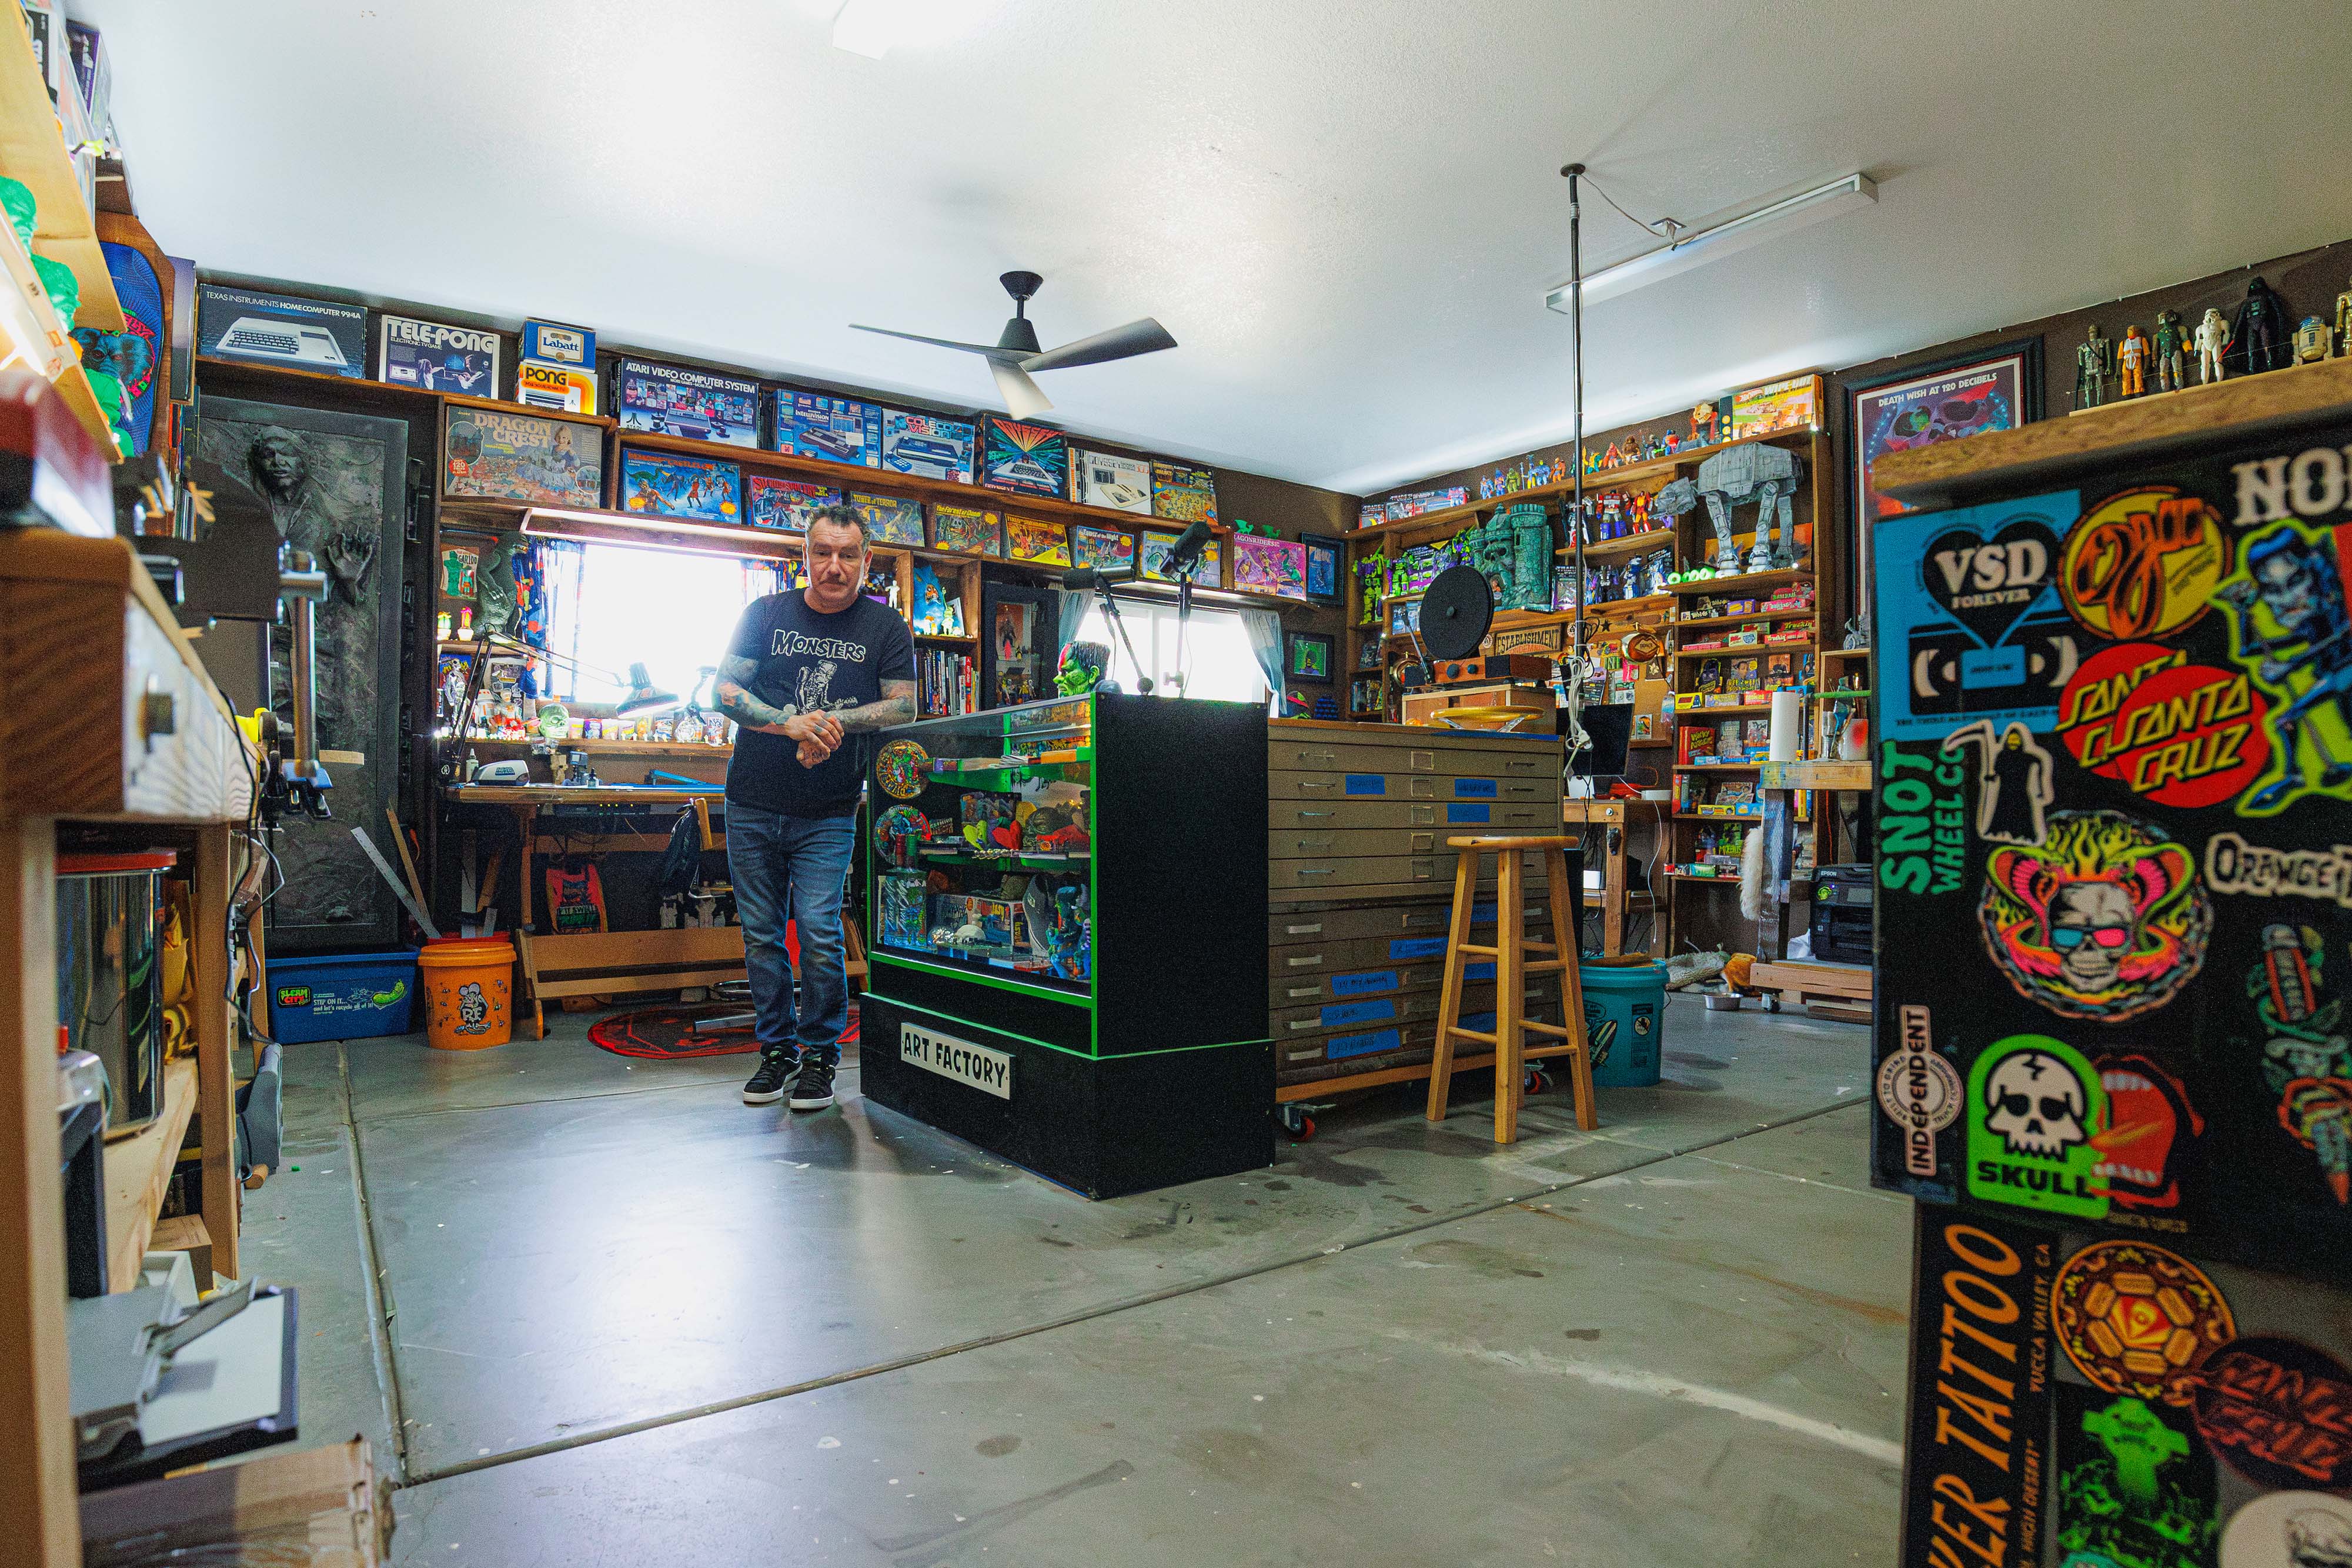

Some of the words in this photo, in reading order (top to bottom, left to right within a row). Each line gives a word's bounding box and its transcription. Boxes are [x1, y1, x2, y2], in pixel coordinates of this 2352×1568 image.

[206, 291, 228, 300] TEXAS
[229, 295, 280, 307] INSTRUMENTS
[280, 302, 303, 311] HOME
[303, 305, 340, 317] COMPUTER
[387, 319, 494, 354] TELE-PONG
[390, 337, 421, 346] ELECTRONIC
[543, 337, 579, 352] Labatt
[526, 367, 566, 386] PONG
[626, 362, 650, 375] ATARI
[651, 367, 678, 379] VIDEO
[680, 372, 724, 389] COMPUTER
[724, 380, 756, 393] SYSTEM
[1878, 393, 1905, 407] DEATH
[1906, 389, 1926, 400] WISH
[1929, 386, 1940, 396] AT
[1941, 382, 1956, 393] 120
[1958, 372, 1997, 389] DECIBELS
[474, 413, 553, 437] DRAGON
[795, 410, 829, 420] INTELLIVISION
[906, 416, 953, 431] COLECO
[908, 424, 951, 439] VISION
[493, 430, 549, 448] CREST
[875, 497, 897, 508] TERROR
[2230, 448, 2352, 525] NO
[1934, 539, 2047, 593] VSD
[1951, 588, 2031, 609] FOREVER
[771, 628, 866, 663] MONSTERS
[1497, 626, 1559, 655] ESTABLISHMENT
[2100, 674, 2252, 755] SANTA
[2132, 723, 2252, 794] CRUZ
[1880, 740, 1934, 894] SNOT
[1930, 793, 1965, 894] WHEEL
[462, 1008, 483, 1022] RF
[904, 1032, 930, 1062] ART
[936, 1042, 1006, 1089] FACTORY
[1906, 1011, 1930, 1170] INDEPENDENT
[1977, 1159, 2099, 1200] SKULL
[2034, 1243, 2050, 1269] CA
[1934, 1223, 2023, 1473] TATTOO
[2029, 1336, 2047, 1393] YUCCA
[2021, 1508, 2037, 1552] HIGH
